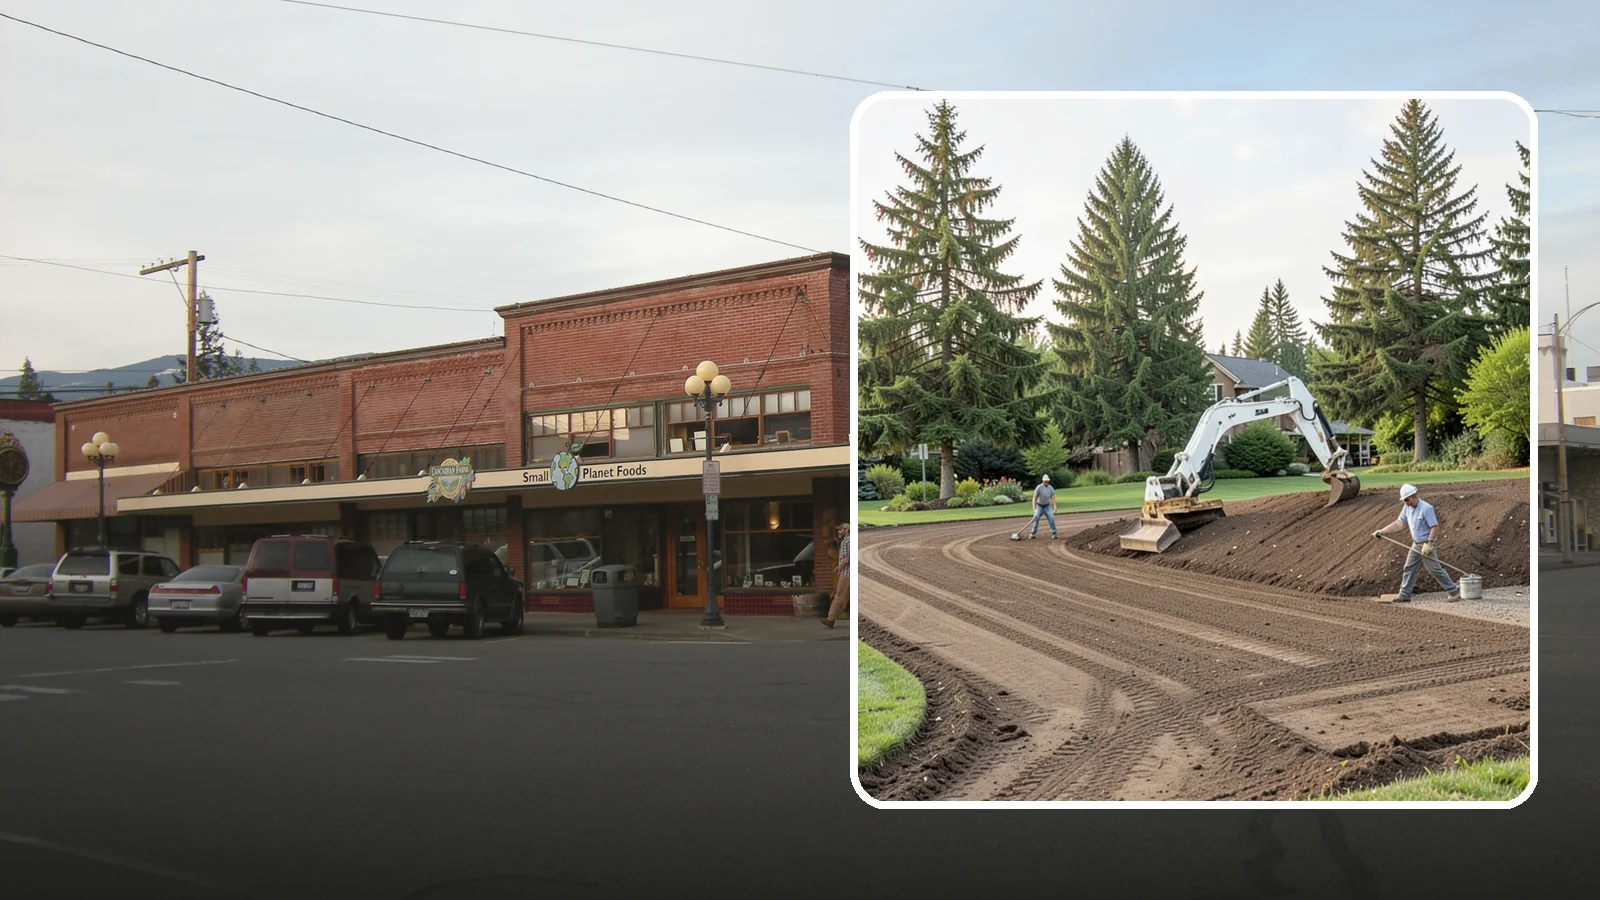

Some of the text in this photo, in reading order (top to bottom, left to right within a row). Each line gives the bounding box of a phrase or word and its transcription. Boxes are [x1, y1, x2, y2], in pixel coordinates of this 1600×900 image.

[523, 464, 647, 483] Small Planet Foods
